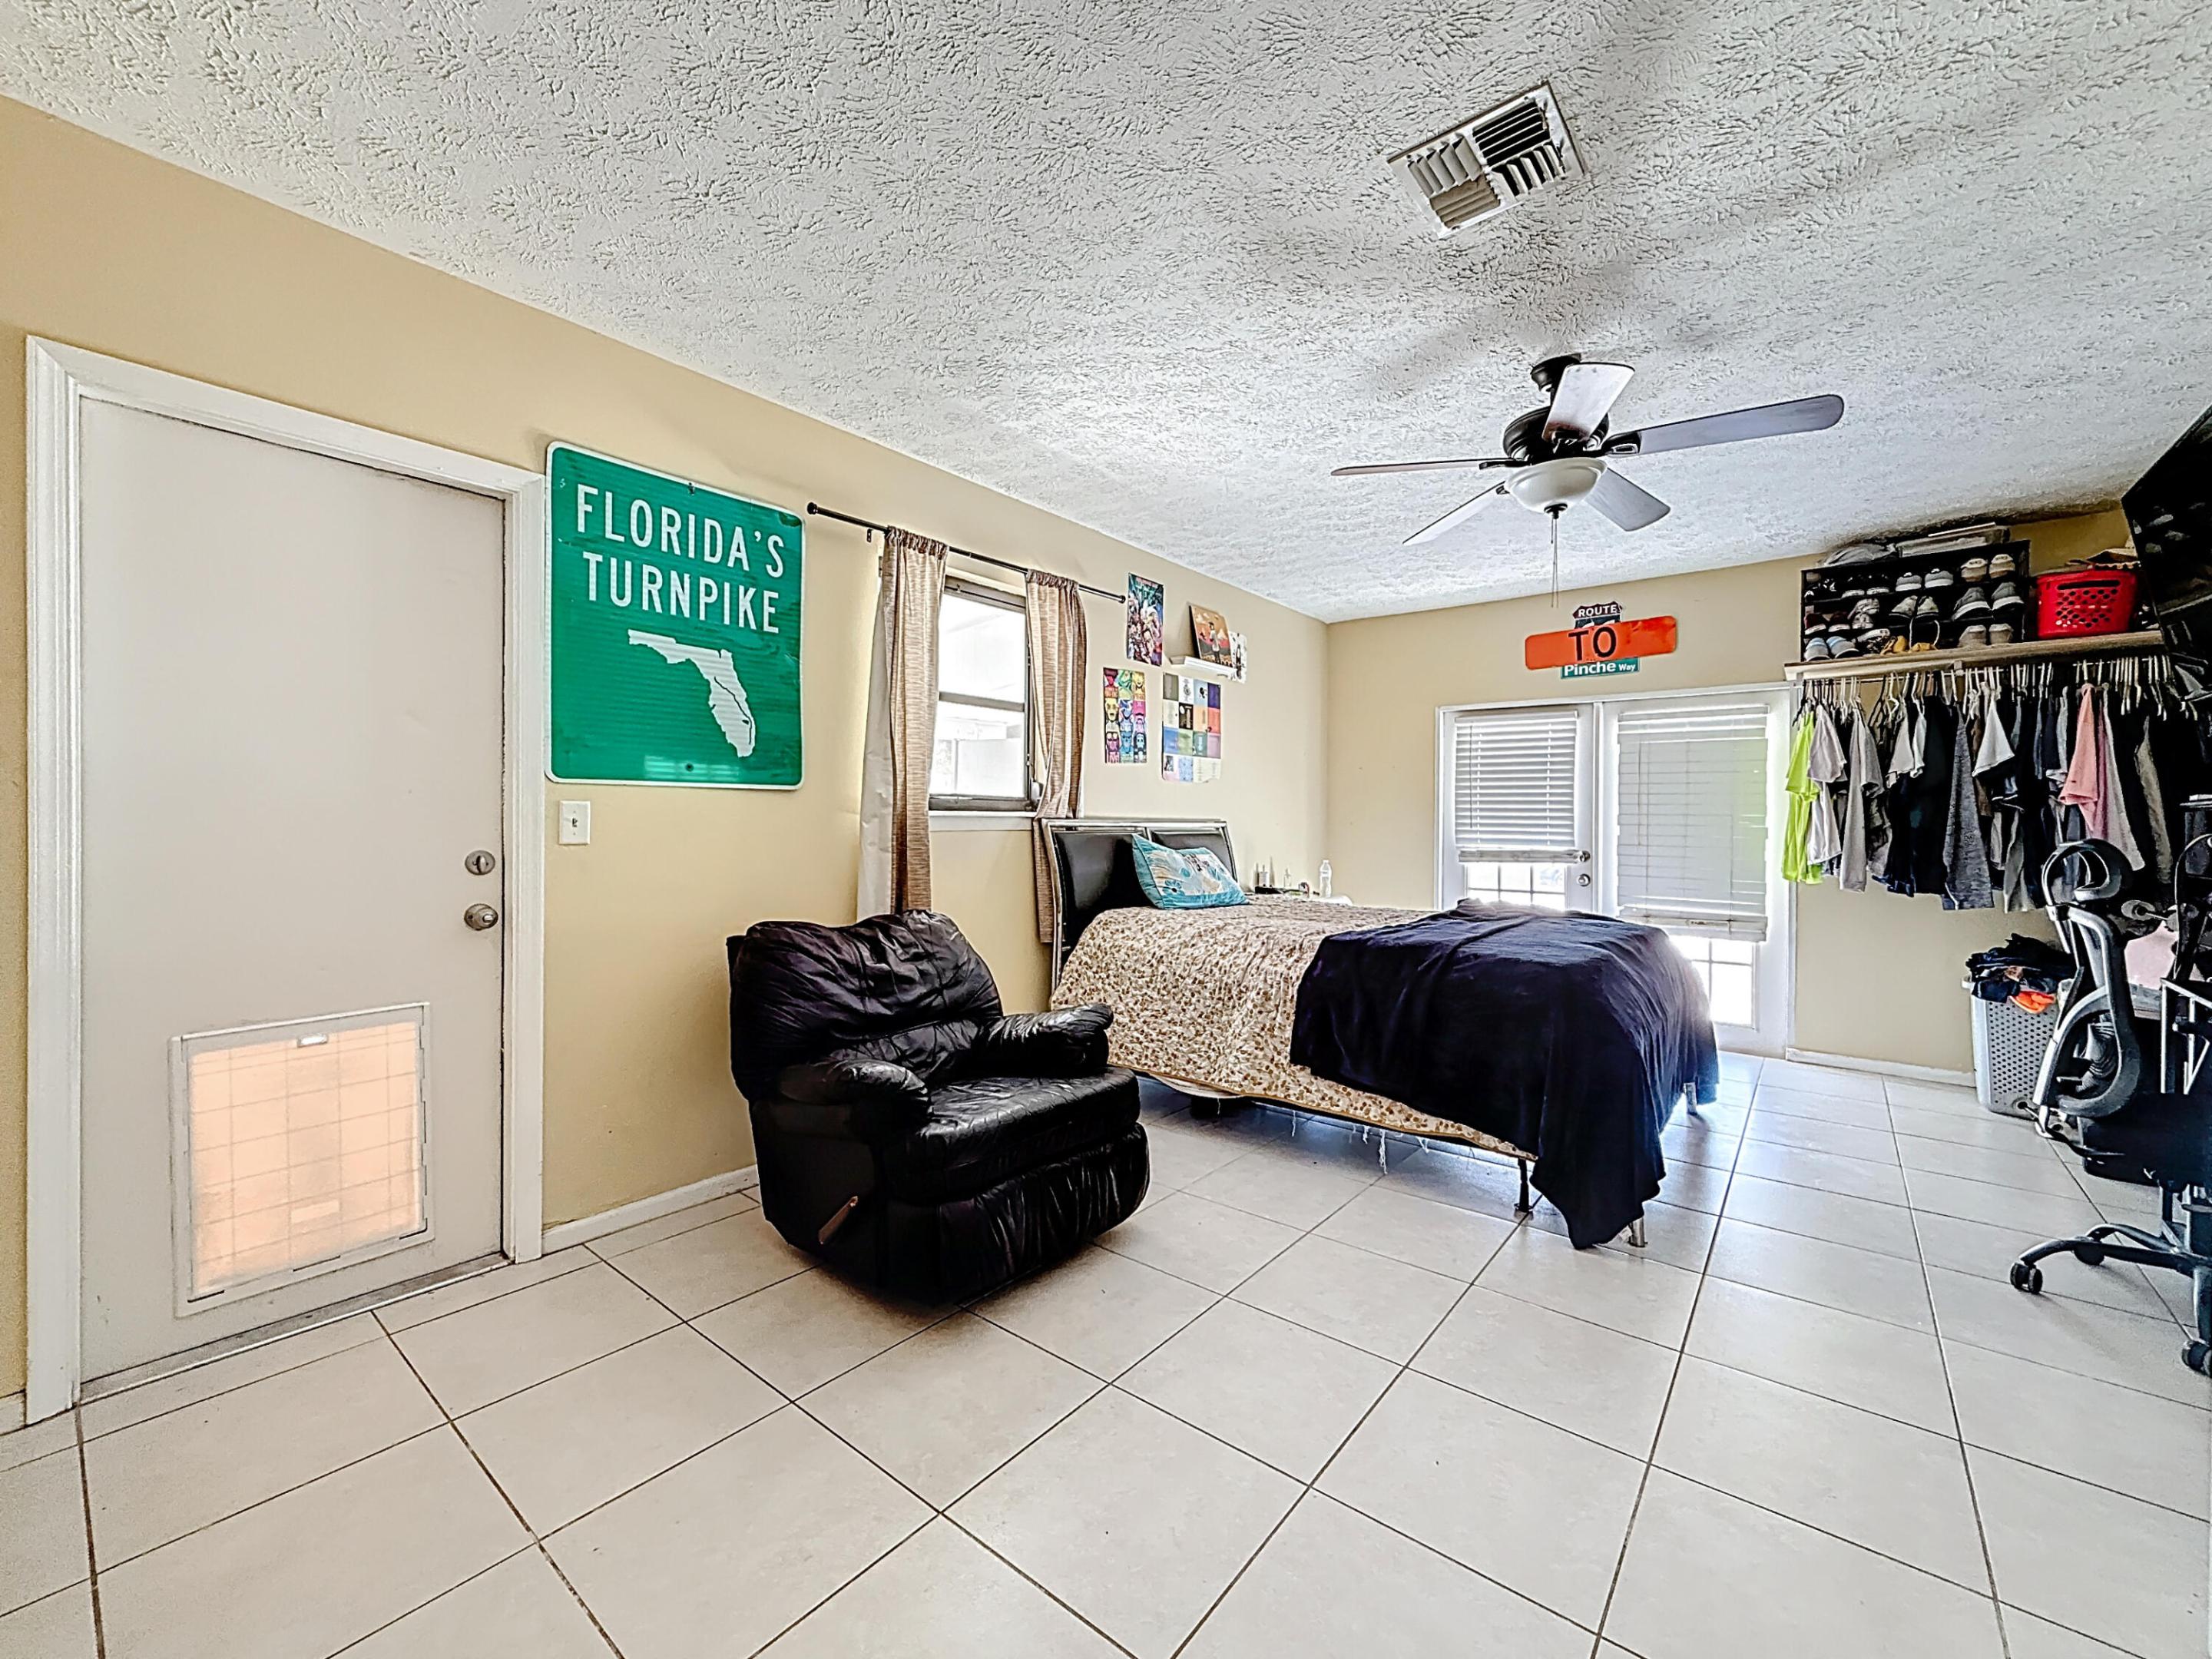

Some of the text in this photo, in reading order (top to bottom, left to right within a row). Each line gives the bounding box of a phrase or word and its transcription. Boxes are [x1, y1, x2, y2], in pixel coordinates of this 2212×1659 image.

[577, 483, 784, 578] FLORIDA'S
[583, 551, 779, 634] TURNPIKE
[1578, 604, 1617, 618] ROUTE
[1568, 627, 1617, 661] TO
[1564, 661, 1636, 676] Pinche Way
